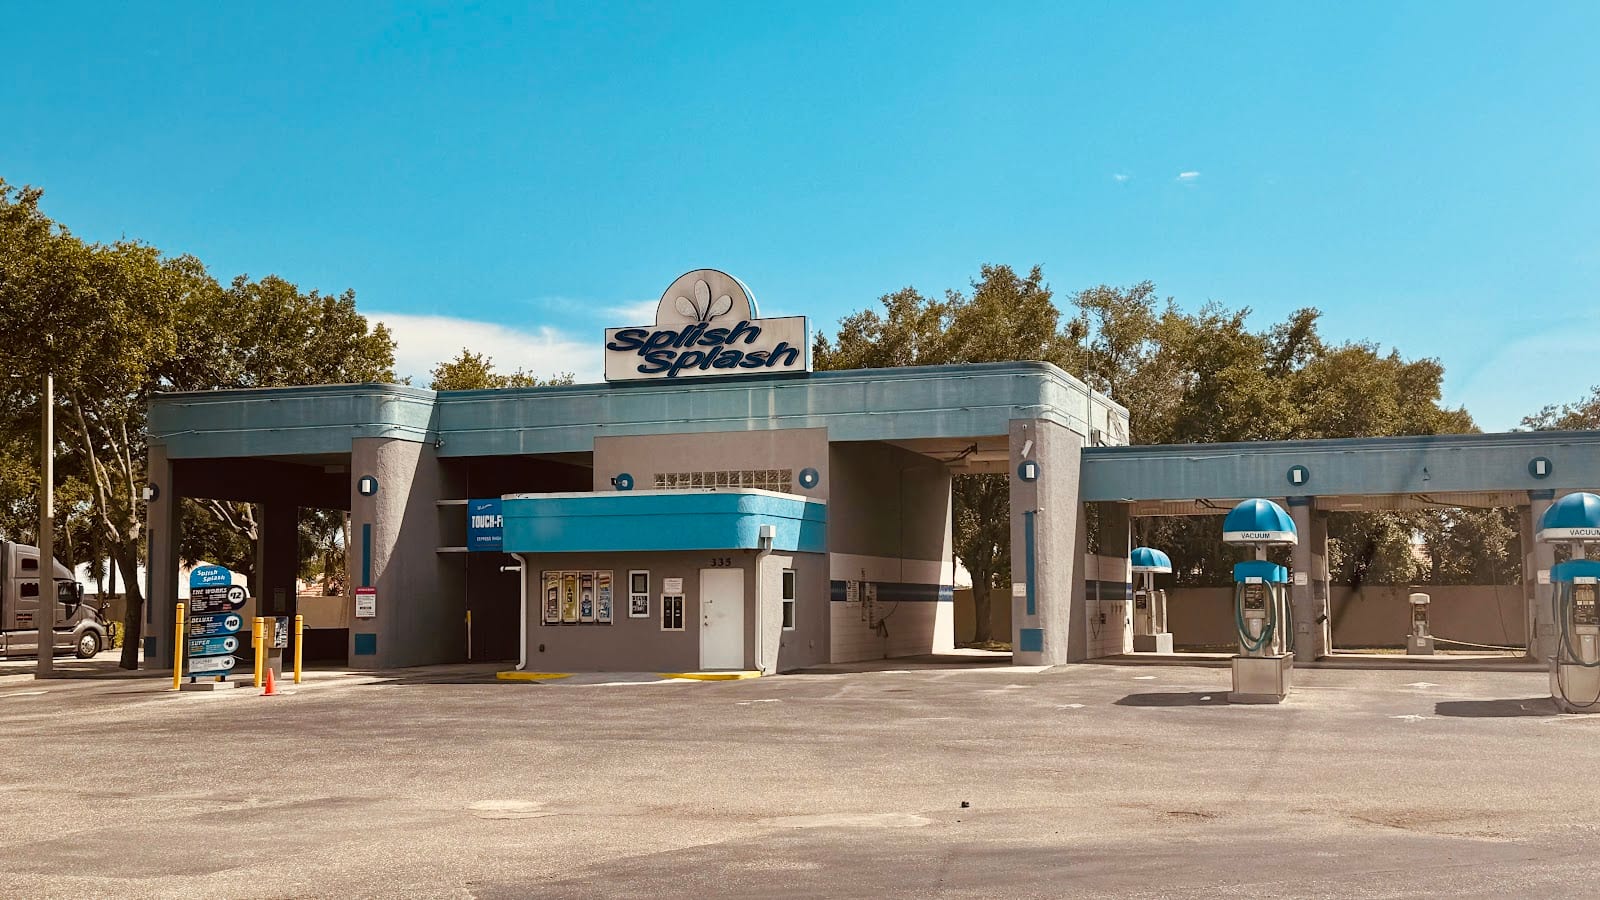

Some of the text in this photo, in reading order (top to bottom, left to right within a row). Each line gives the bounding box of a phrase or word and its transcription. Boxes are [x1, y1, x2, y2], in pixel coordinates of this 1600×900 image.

[607, 320, 762, 356] Splish
[637, 341, 800, 378] Splash
[710, 557, 732, 567] 335
[197, 569, 218, 577] Splish
[202, 574, 226, 583] Splash
[205, 587, 228, 595] WORKS
